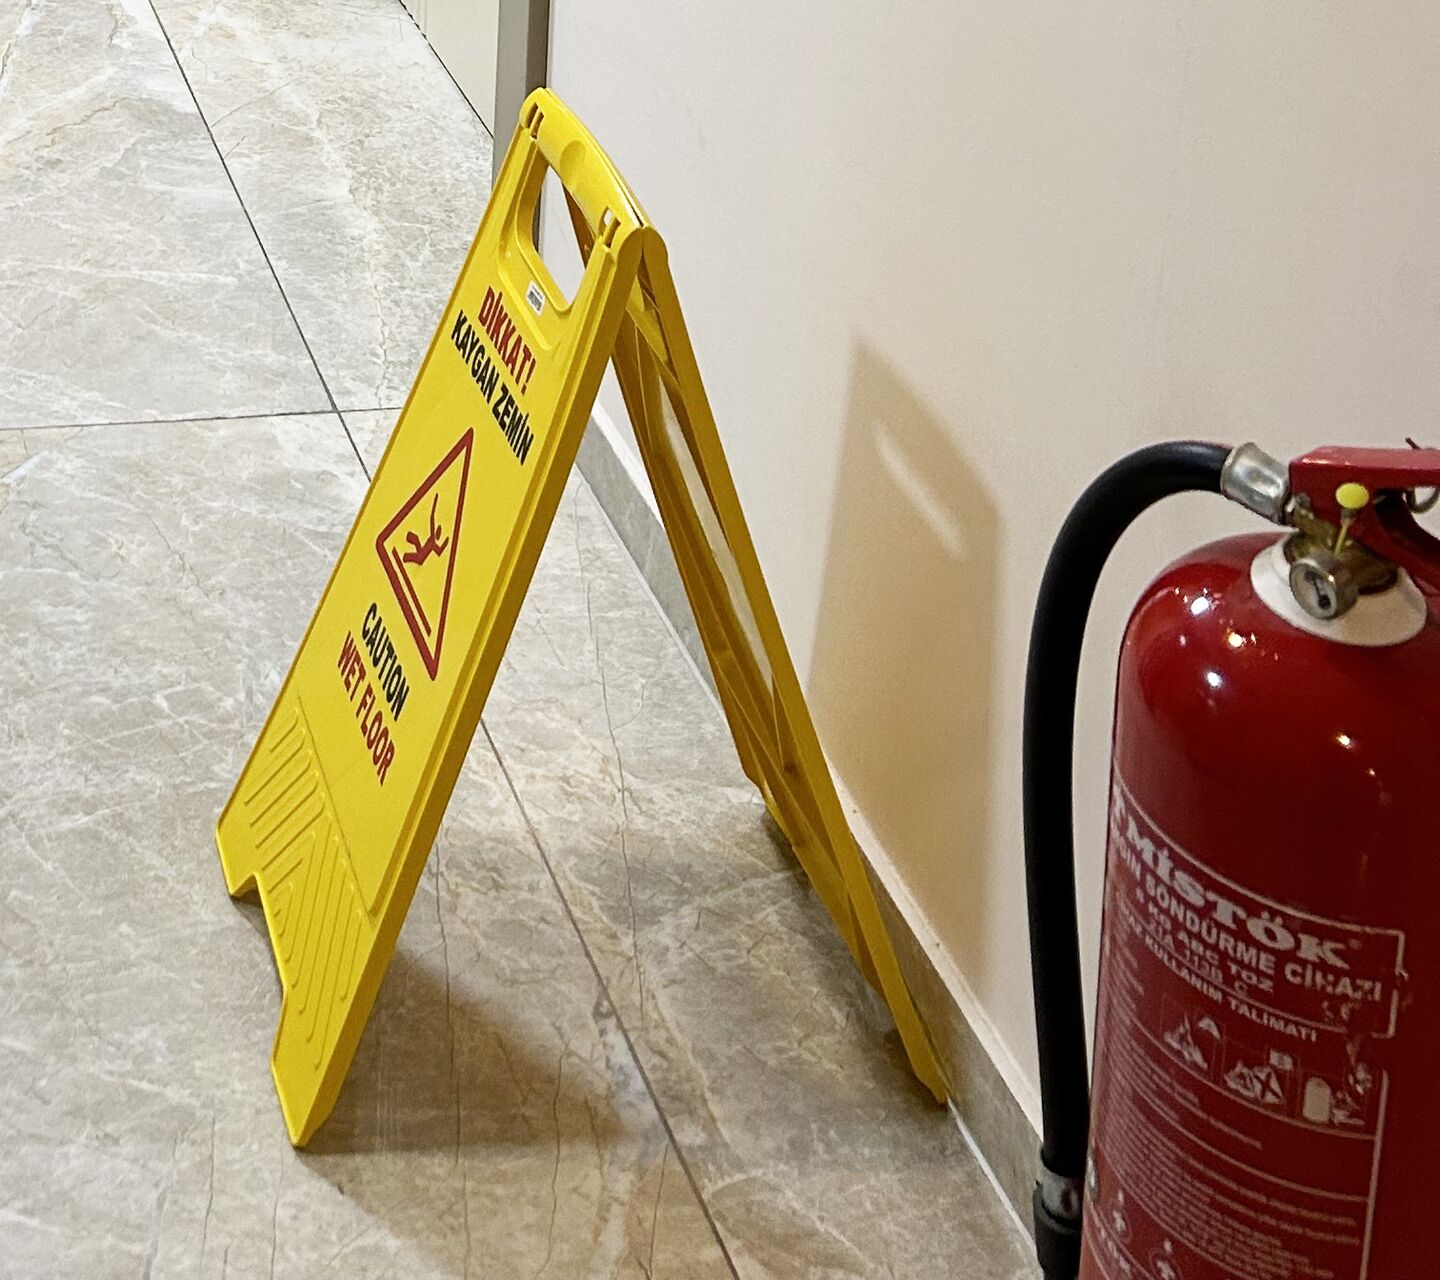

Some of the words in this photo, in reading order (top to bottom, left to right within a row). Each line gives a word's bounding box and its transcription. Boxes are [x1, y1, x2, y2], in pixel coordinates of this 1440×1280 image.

[450, 309, 500, 405] KAYGAN
[491, 382, 535, 466] ZEMİN
[477, 286, 537, 396] DİKKAT!
[337, 630, 367, 702] WET
[355, 682, 395, 787] FLOOR
[361, 602, 410, 722] CAUTION
[1227, 958, 1274, 993] TOZ
